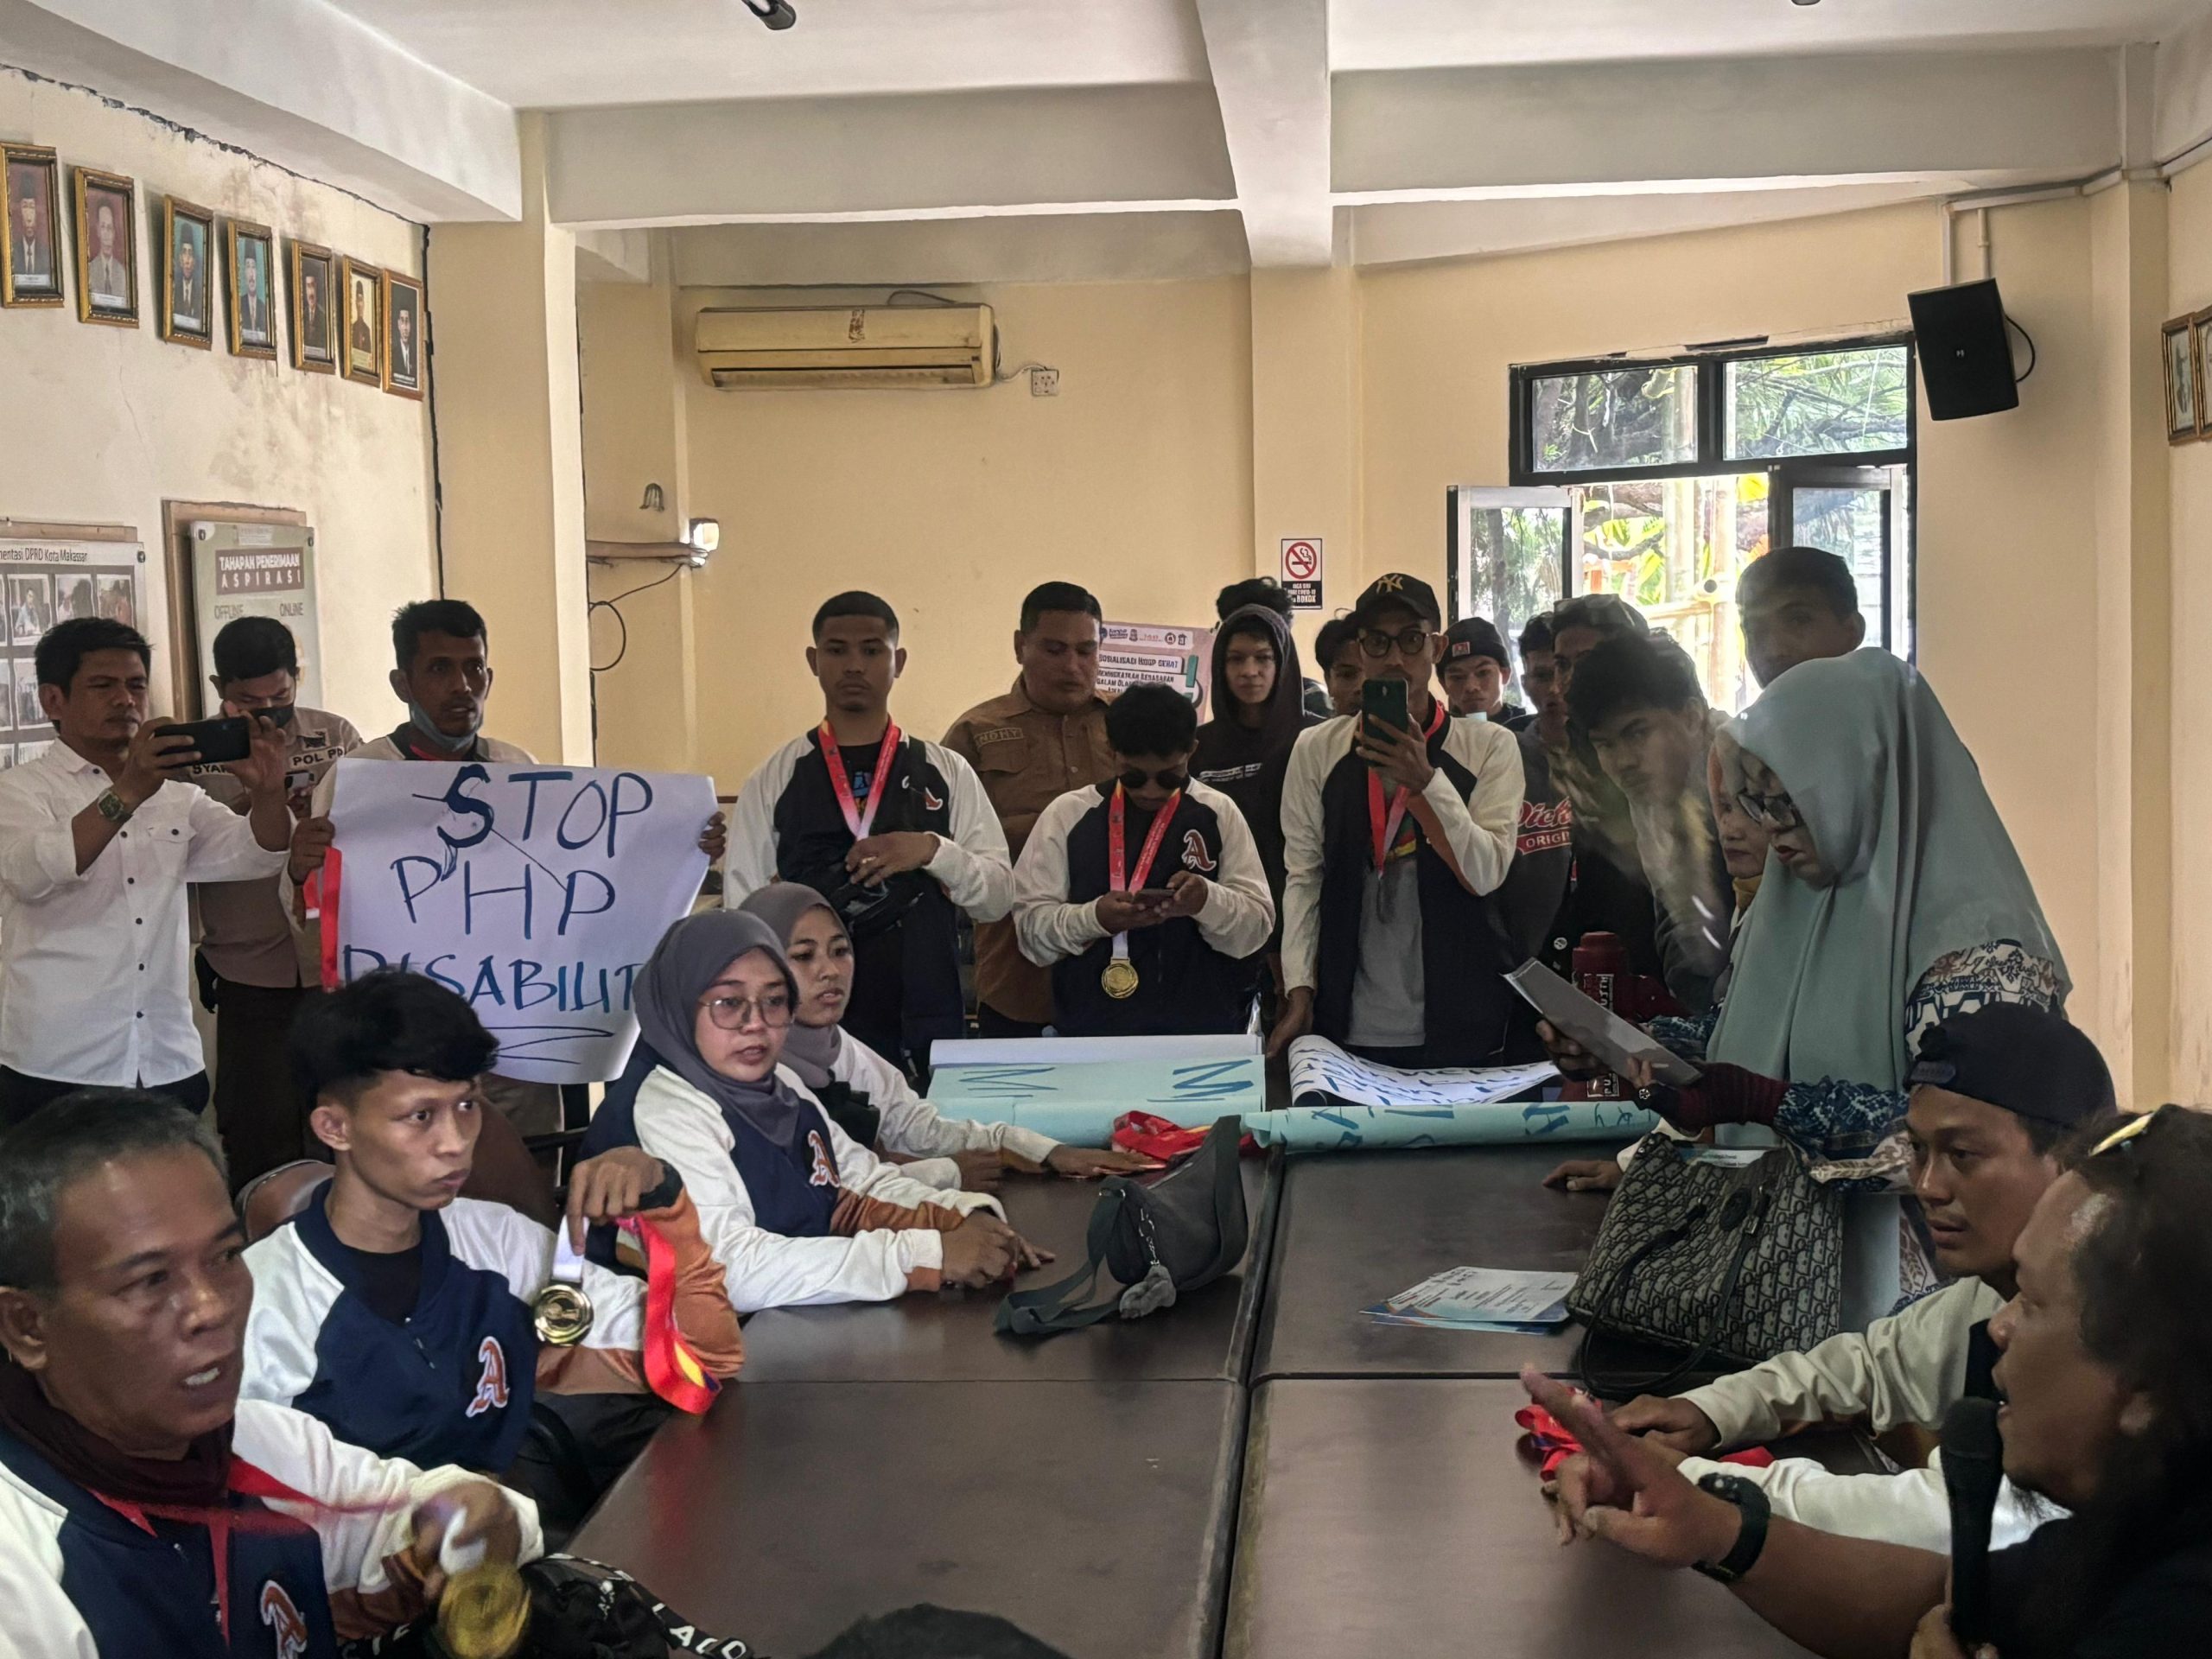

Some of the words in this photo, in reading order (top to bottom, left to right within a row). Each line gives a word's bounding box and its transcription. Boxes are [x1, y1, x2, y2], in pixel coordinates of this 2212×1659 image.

[24, 547, 43, 561] DPRD
[44, 549, 59, 562] Kota
[60, 549, 88, 563] Makassar
[219, 555, 256, 571] TAHAPAN
[256, 553, 301, 569] PENERIMAAN
[221, 569, 302, 588] ASPIRASI
[213, 604, 244, 620] OFFLINE
[279, 602, 304, 617] ONLINE
[292, 753, 324, 767] POL
[437, 763, 653, 858] STOP
[390, 855, 615, 939] PHP
